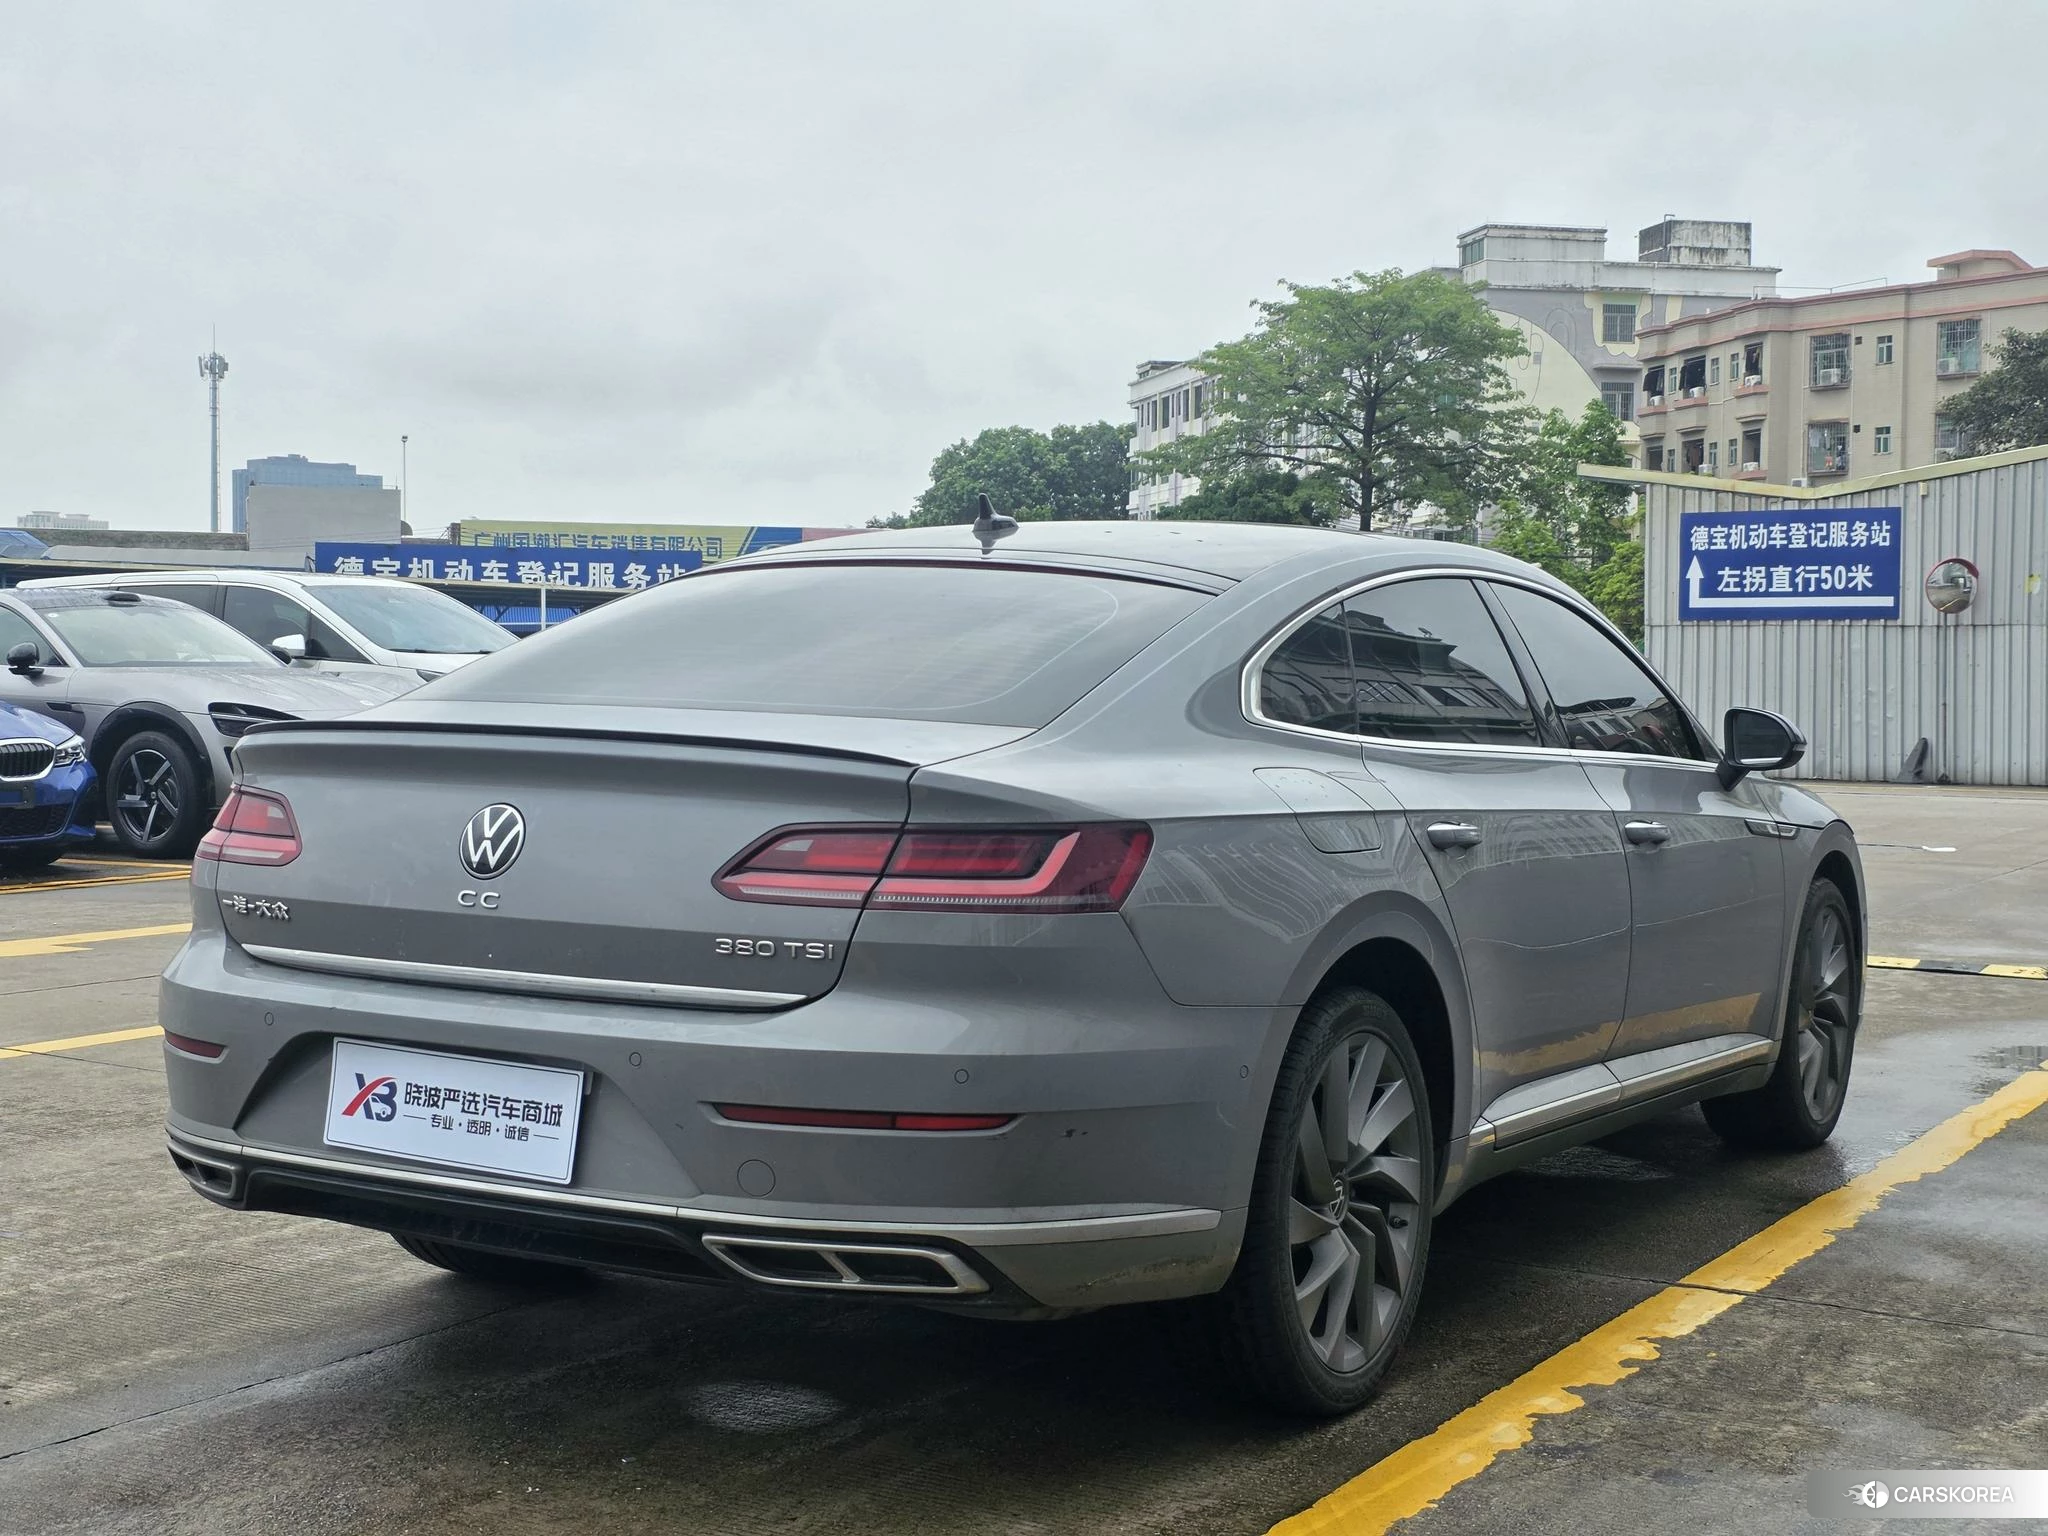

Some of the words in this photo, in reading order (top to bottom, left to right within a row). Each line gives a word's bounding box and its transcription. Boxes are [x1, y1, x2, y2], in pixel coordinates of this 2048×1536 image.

[1690, 520, 1890, 551] 德宝机动车登记服务站
[1717, 564, 1873, 593] 左拐直行50米
[457, 889, 501, 909] CC
[715, 937, 776, 957] 380
[403, 1081, 564, 1128] 晓波严选汽车商城
